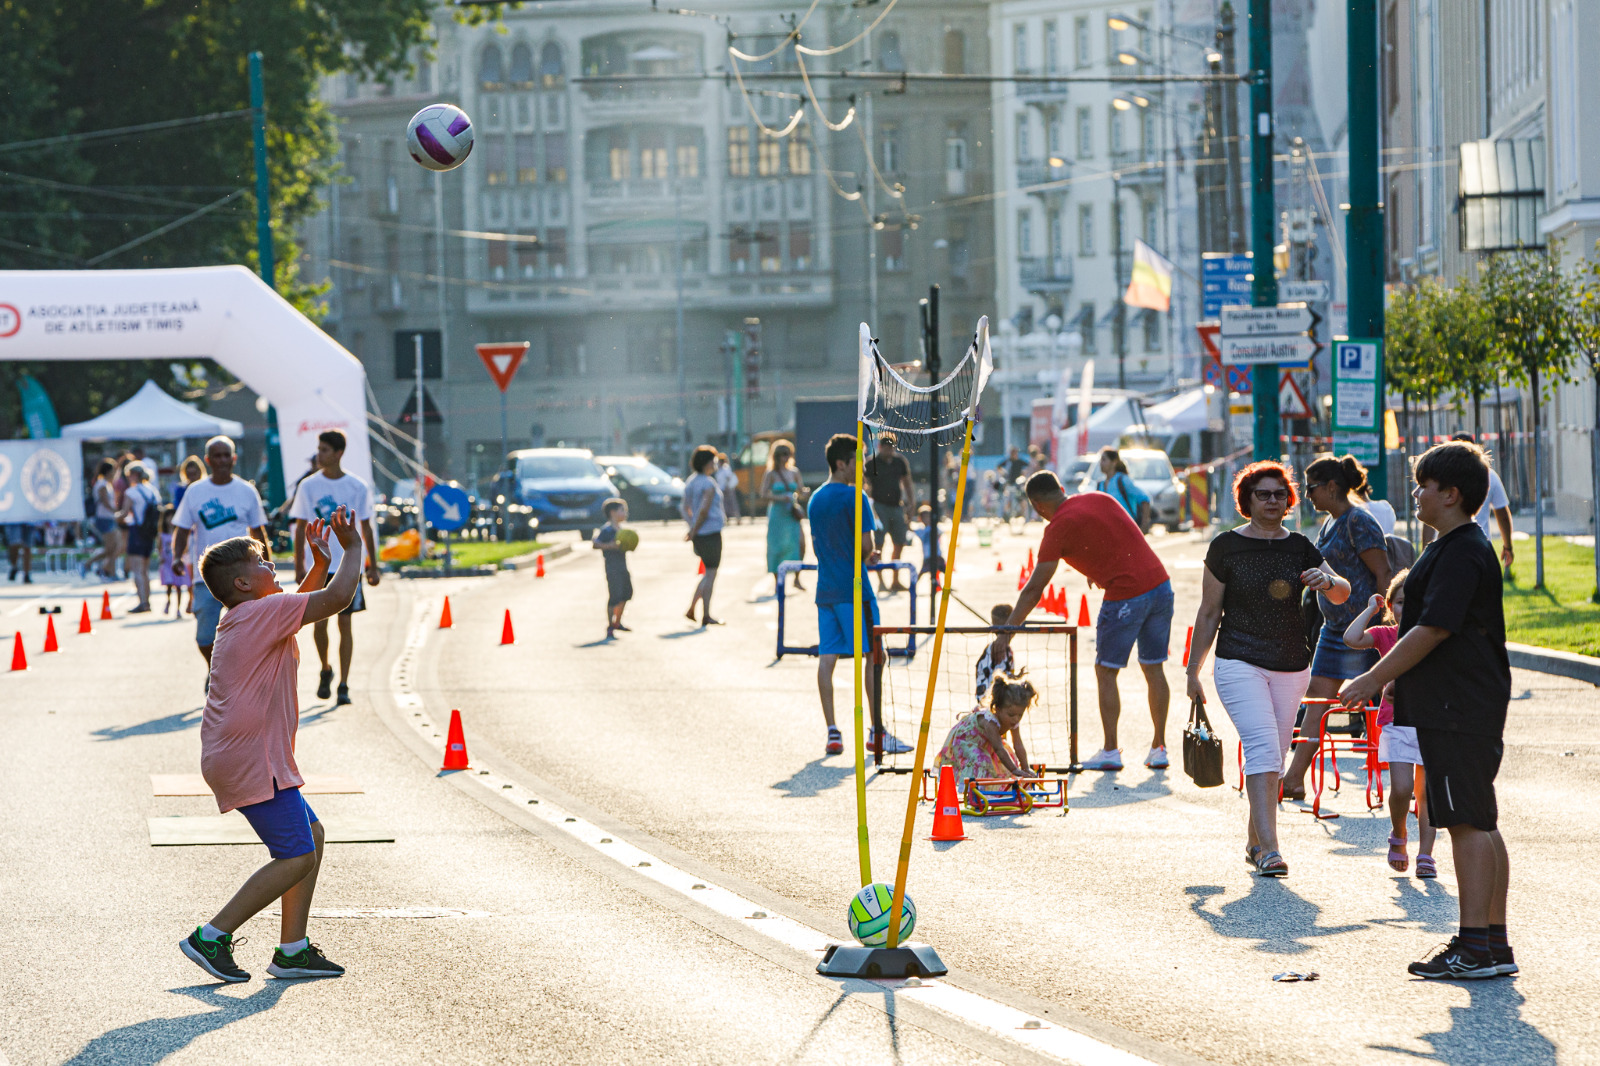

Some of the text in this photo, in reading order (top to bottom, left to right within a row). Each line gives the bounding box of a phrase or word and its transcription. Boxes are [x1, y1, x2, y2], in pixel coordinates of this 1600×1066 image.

[44, 320, 64, 334] DE
[69, 319, 141, 334] ATLETISM
[1345, 348, 1358, 368] P
